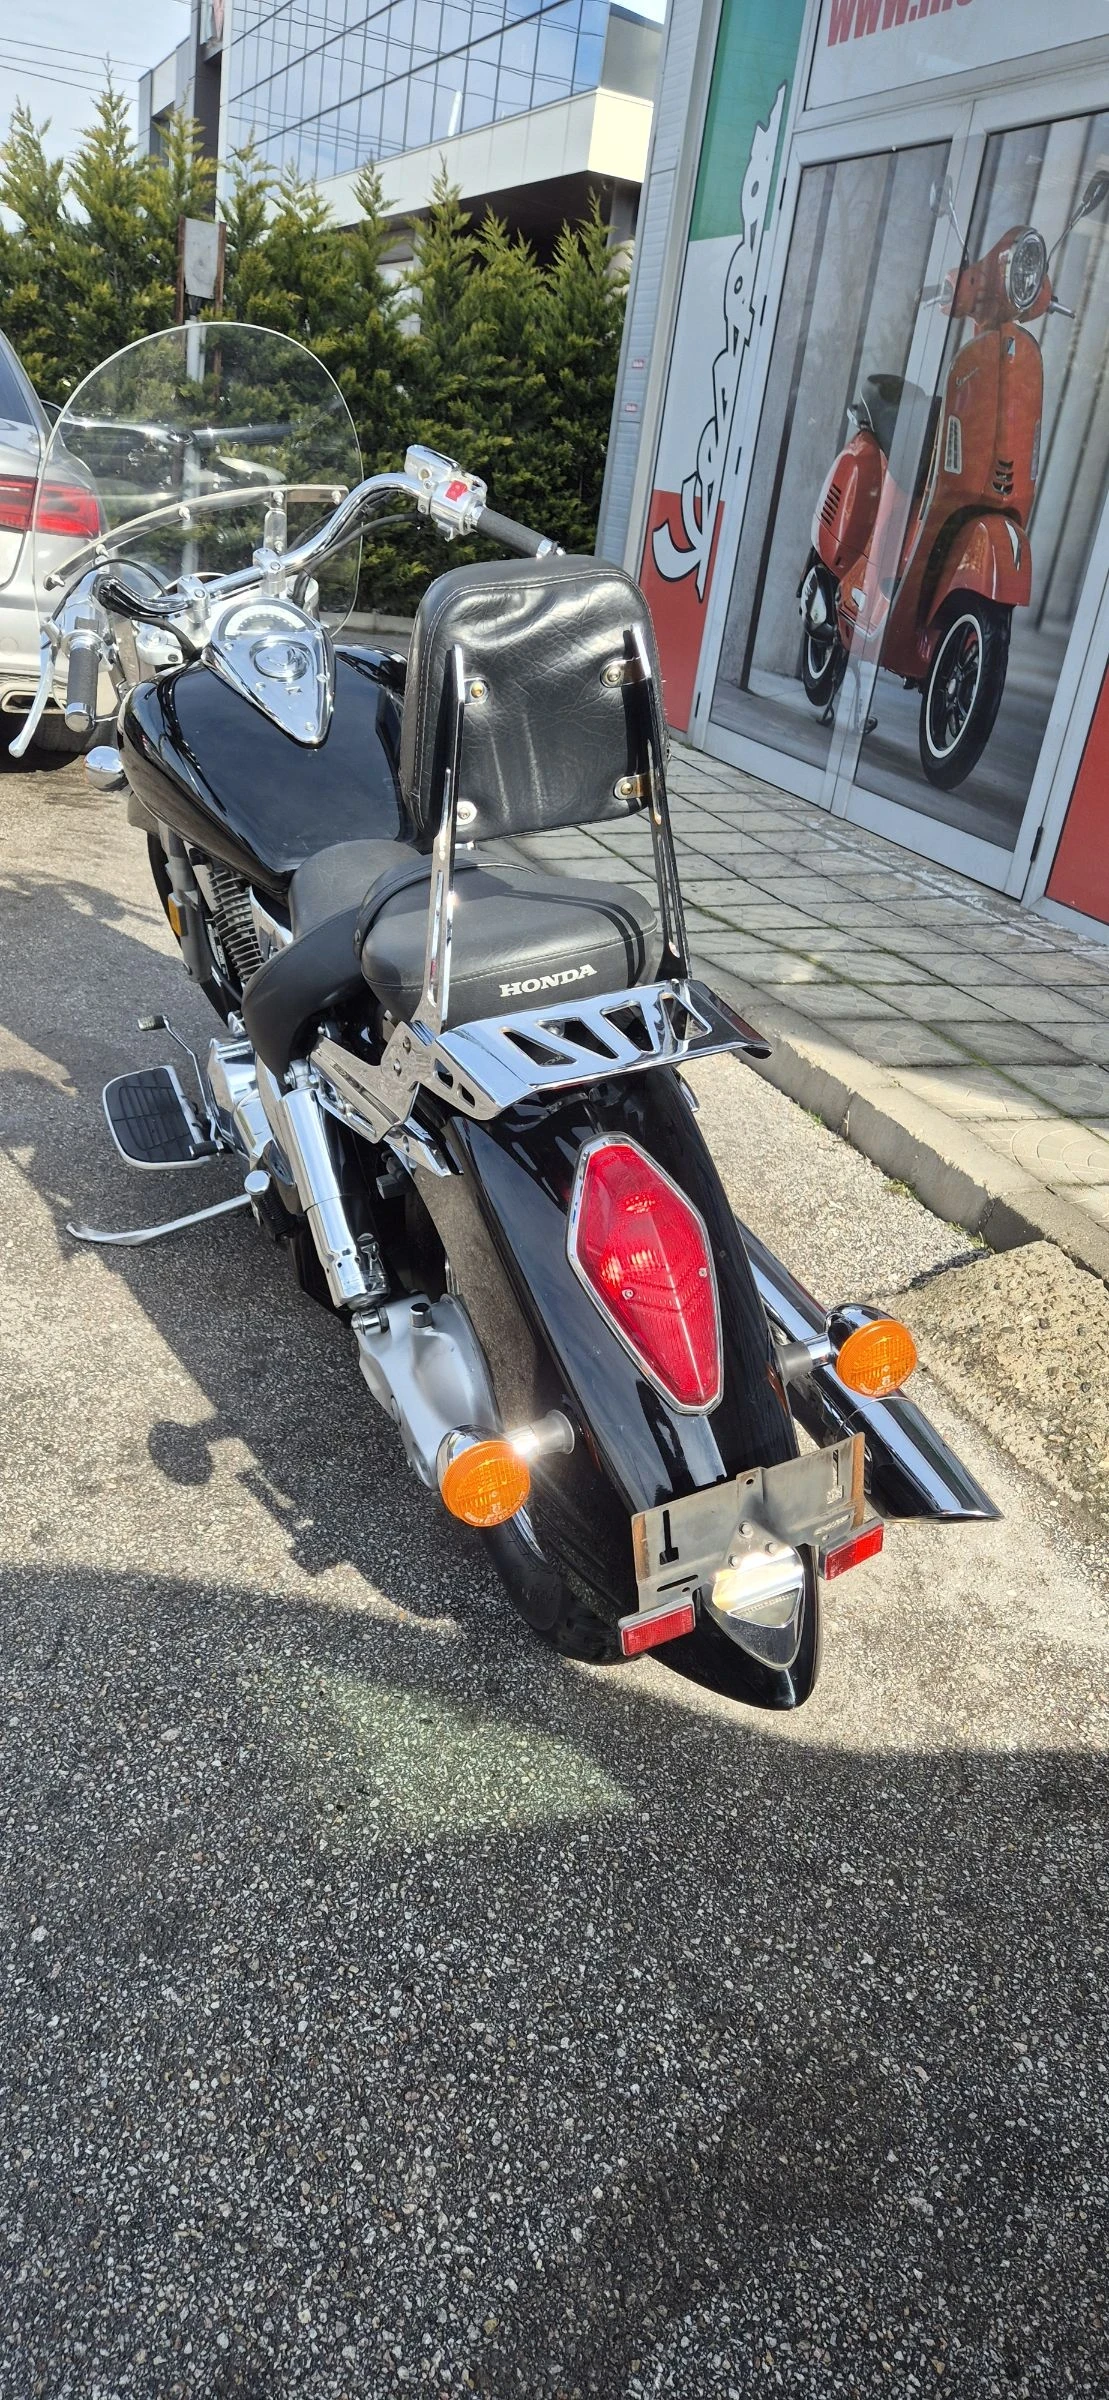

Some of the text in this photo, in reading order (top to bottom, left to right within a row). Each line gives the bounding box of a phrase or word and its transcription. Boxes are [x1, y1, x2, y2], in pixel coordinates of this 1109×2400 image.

[827, 0, 973, 47] www.
[652, 79, 788, 602] Vespa
[499, 964, 598, 998] HONDA
